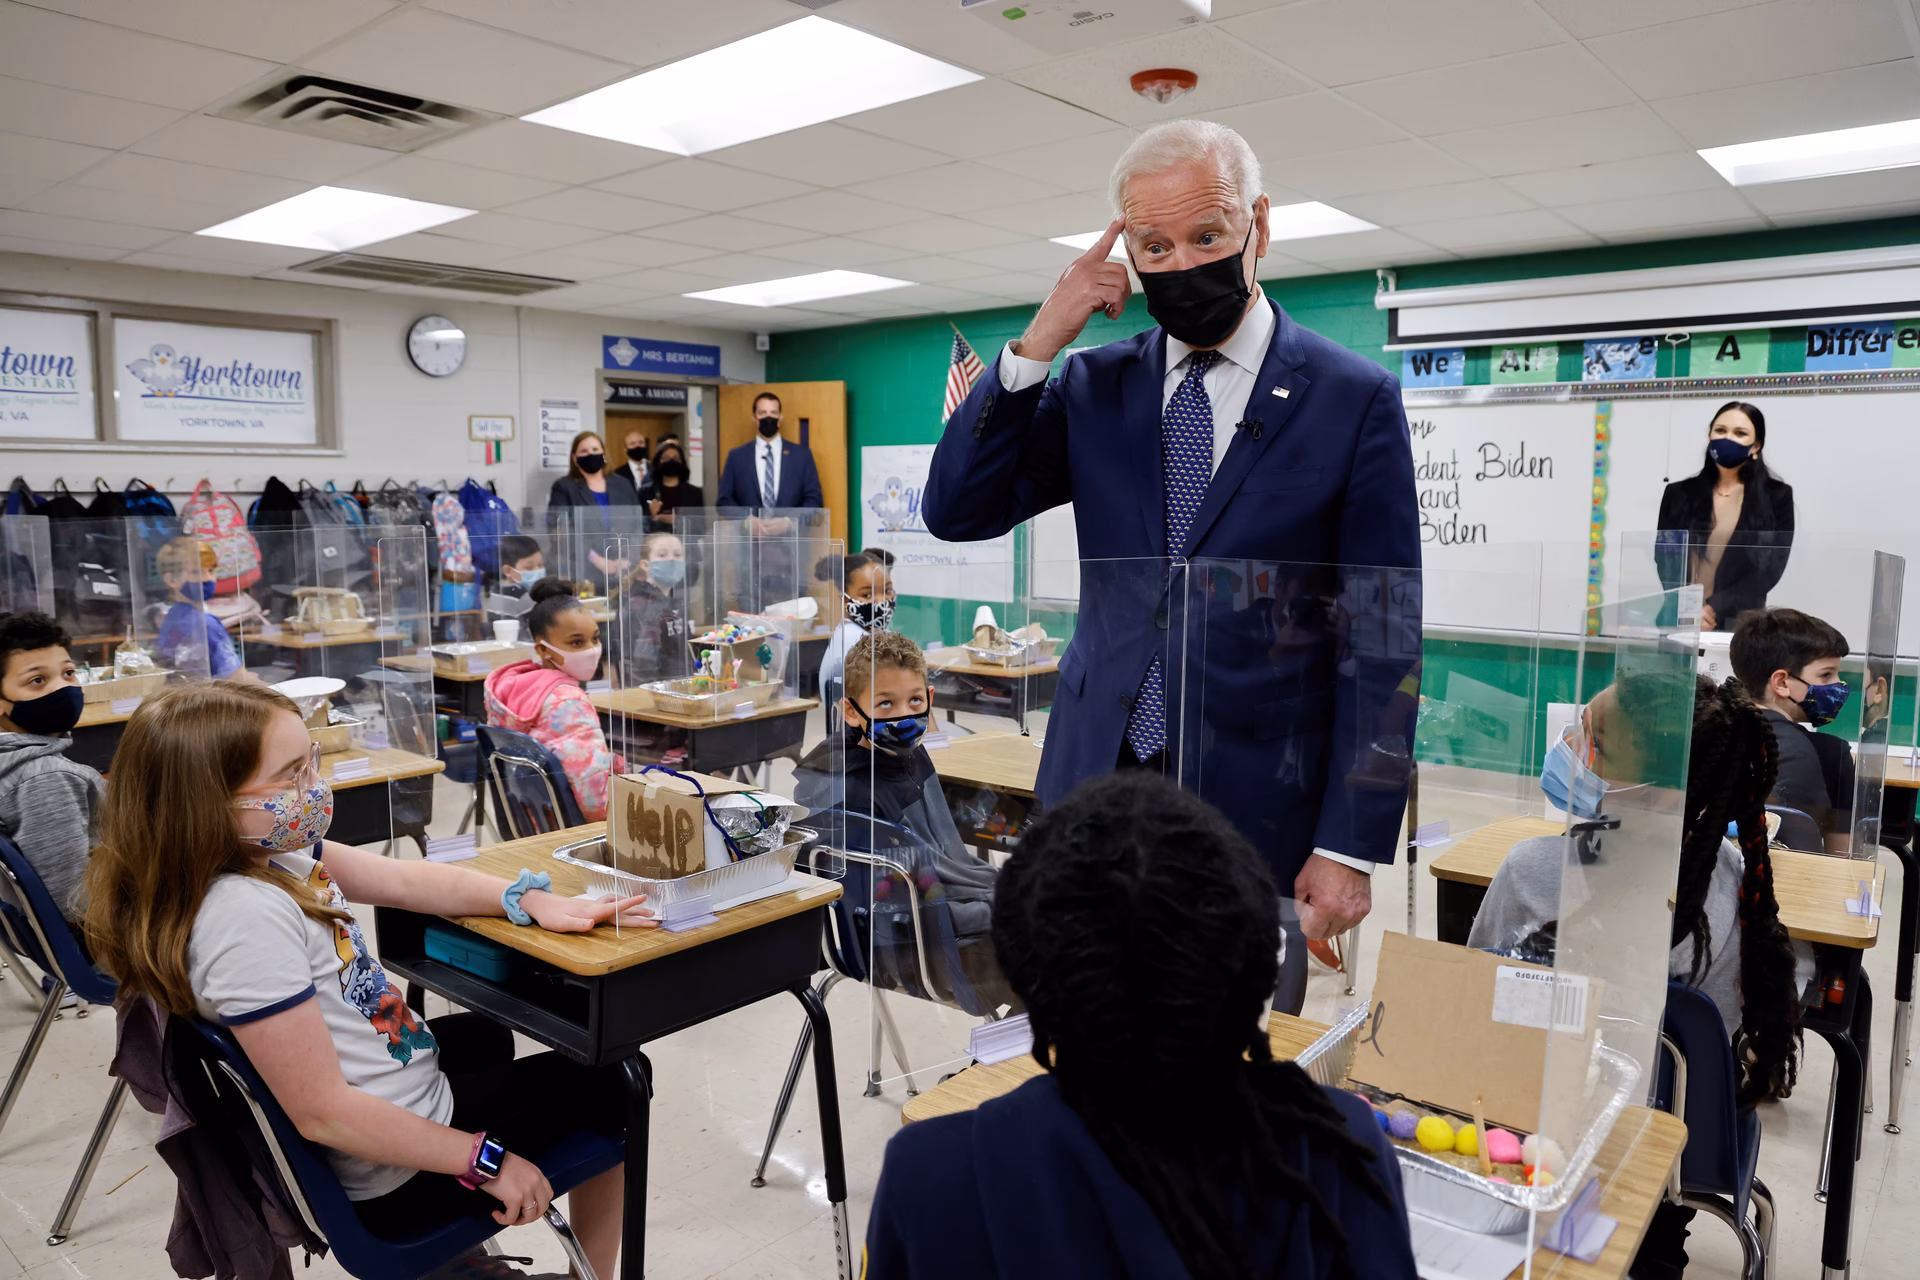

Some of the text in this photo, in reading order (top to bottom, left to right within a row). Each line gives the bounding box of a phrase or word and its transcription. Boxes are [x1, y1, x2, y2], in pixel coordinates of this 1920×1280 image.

[1069, 12, 1115, 27] CASIO
[642, 350, 715, 366] MRS. BERTAMINI
[1411, 351, 1449, 377] We
[1715, 334, 1741, 362] A
[179, 355, 304, 394] Yorktown
[618, 387, 642, 398] MRS.
[1475, 441, 1553, 482] Biden
[1419, 482, 1462, 510] and
